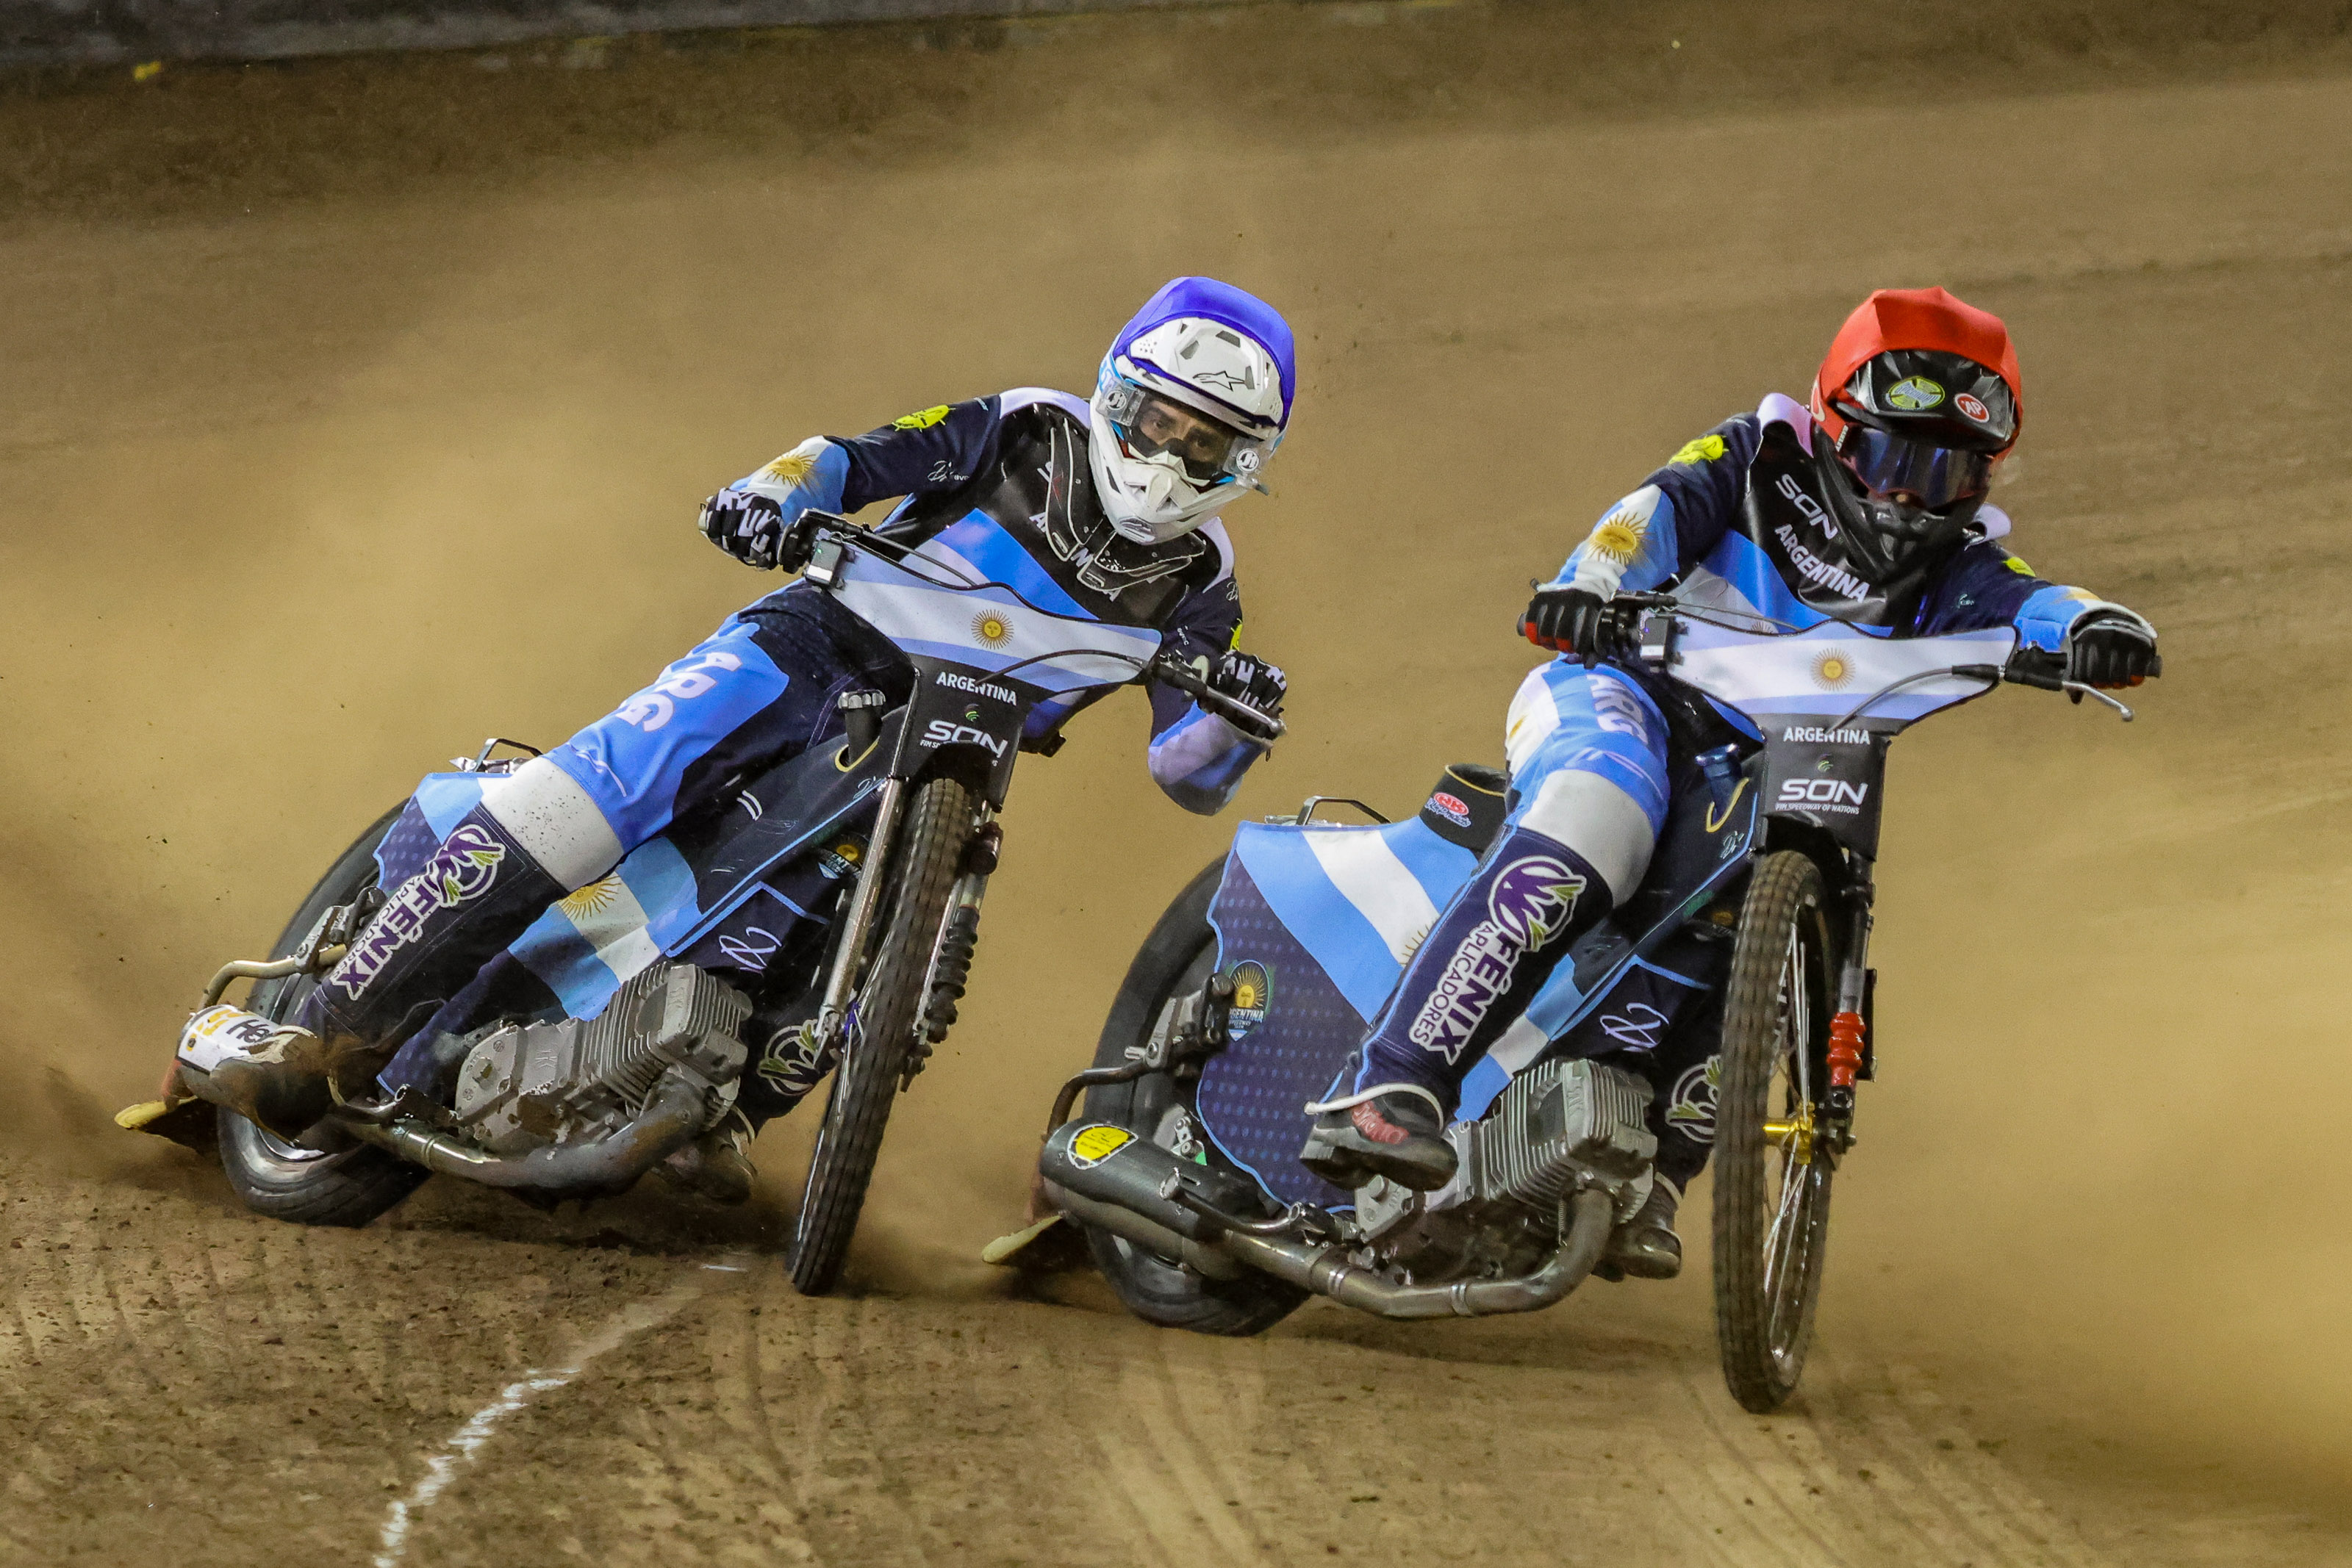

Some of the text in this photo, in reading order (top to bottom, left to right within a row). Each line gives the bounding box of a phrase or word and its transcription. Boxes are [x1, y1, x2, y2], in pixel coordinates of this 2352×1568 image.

[1775, 473, 1838, 540] SON
[1774, 523, 1871, 604] ARGENTINA
[936, 672, 1017, 706] ARGENTINA
[924, 720, 1008, 758] SON
[1783, 727, 1871, 745] ARGENTINA
[1777, 778, 1868, 805] SON
[1832, 805, 1860, 815] NATIONS
[1413, 923, 1493, 1044] APLICADORES
